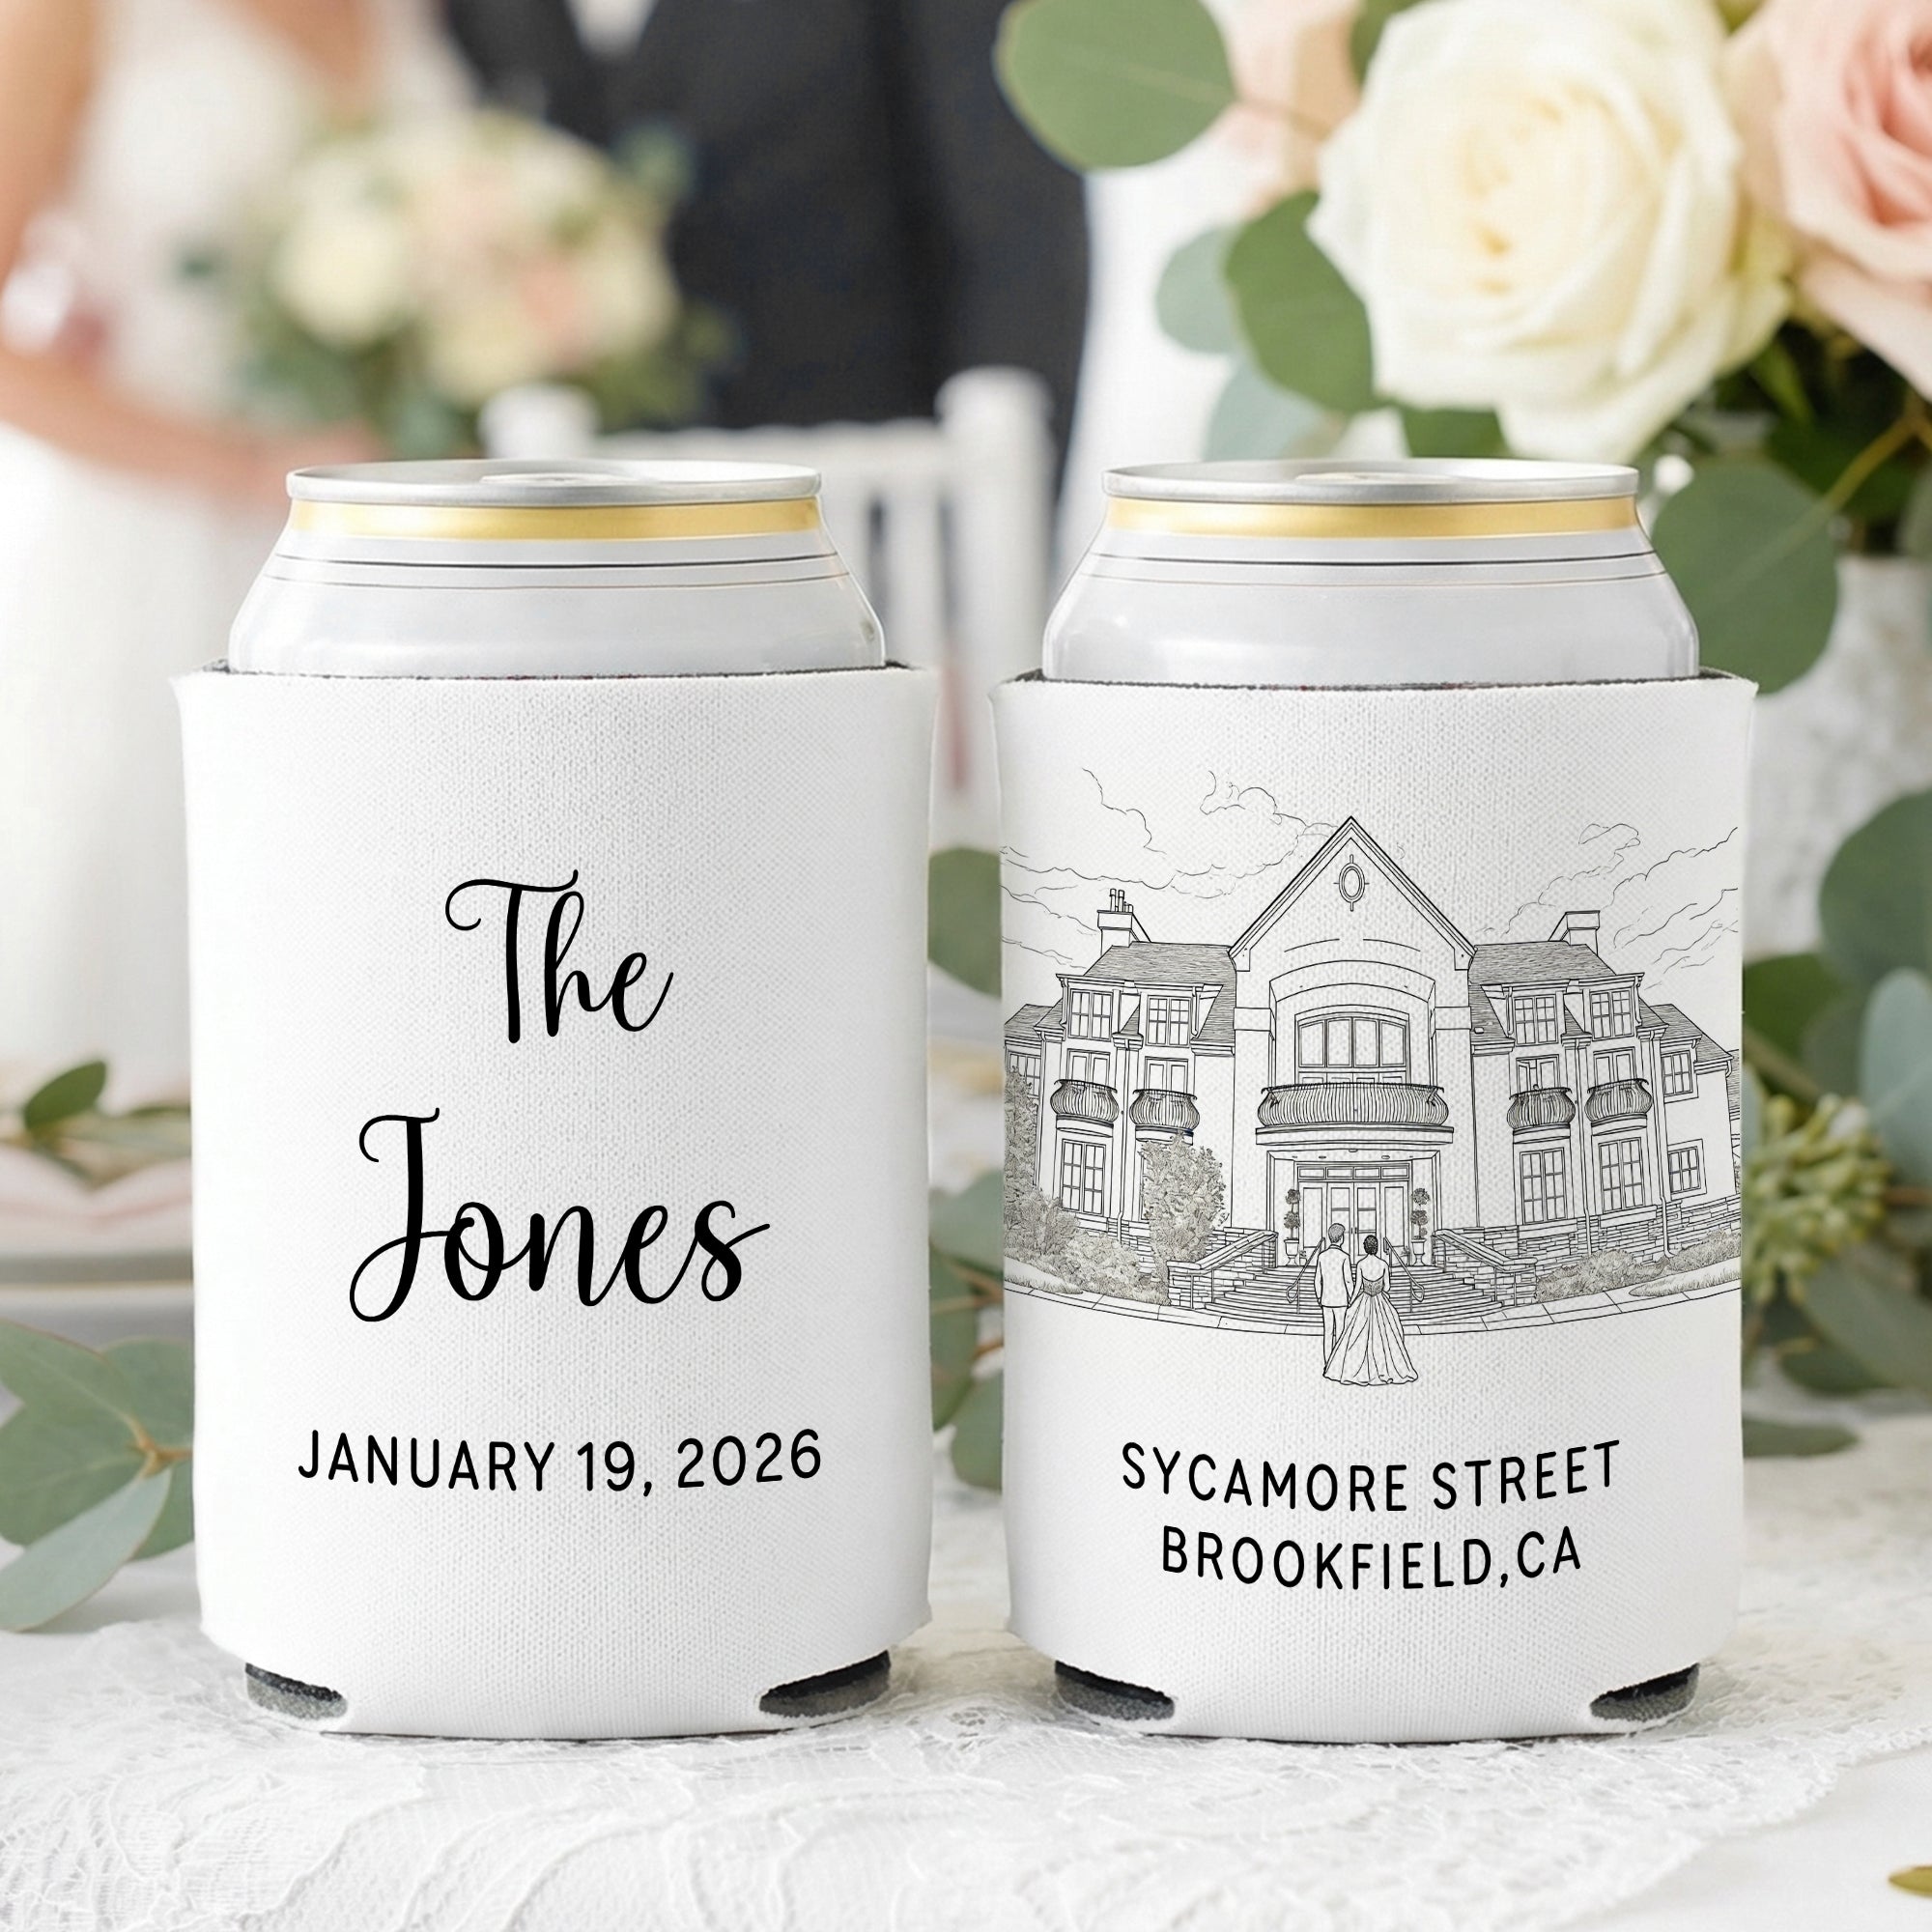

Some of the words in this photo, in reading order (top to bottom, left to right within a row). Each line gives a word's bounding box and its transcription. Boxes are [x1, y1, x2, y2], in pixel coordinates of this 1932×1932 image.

[444, 868, 674, 1044] The
[349, 1107, 771, 1322] Jones
[298, 1429, 555, 1492] JANUARY
[577, 1440, 653, 1497] 19,
[677, 1428, 821, 1489] 2026
[1122, 1441, 1407, 1513] SYCAMORE
[1432, 1439, 1620, 1511] STREET
